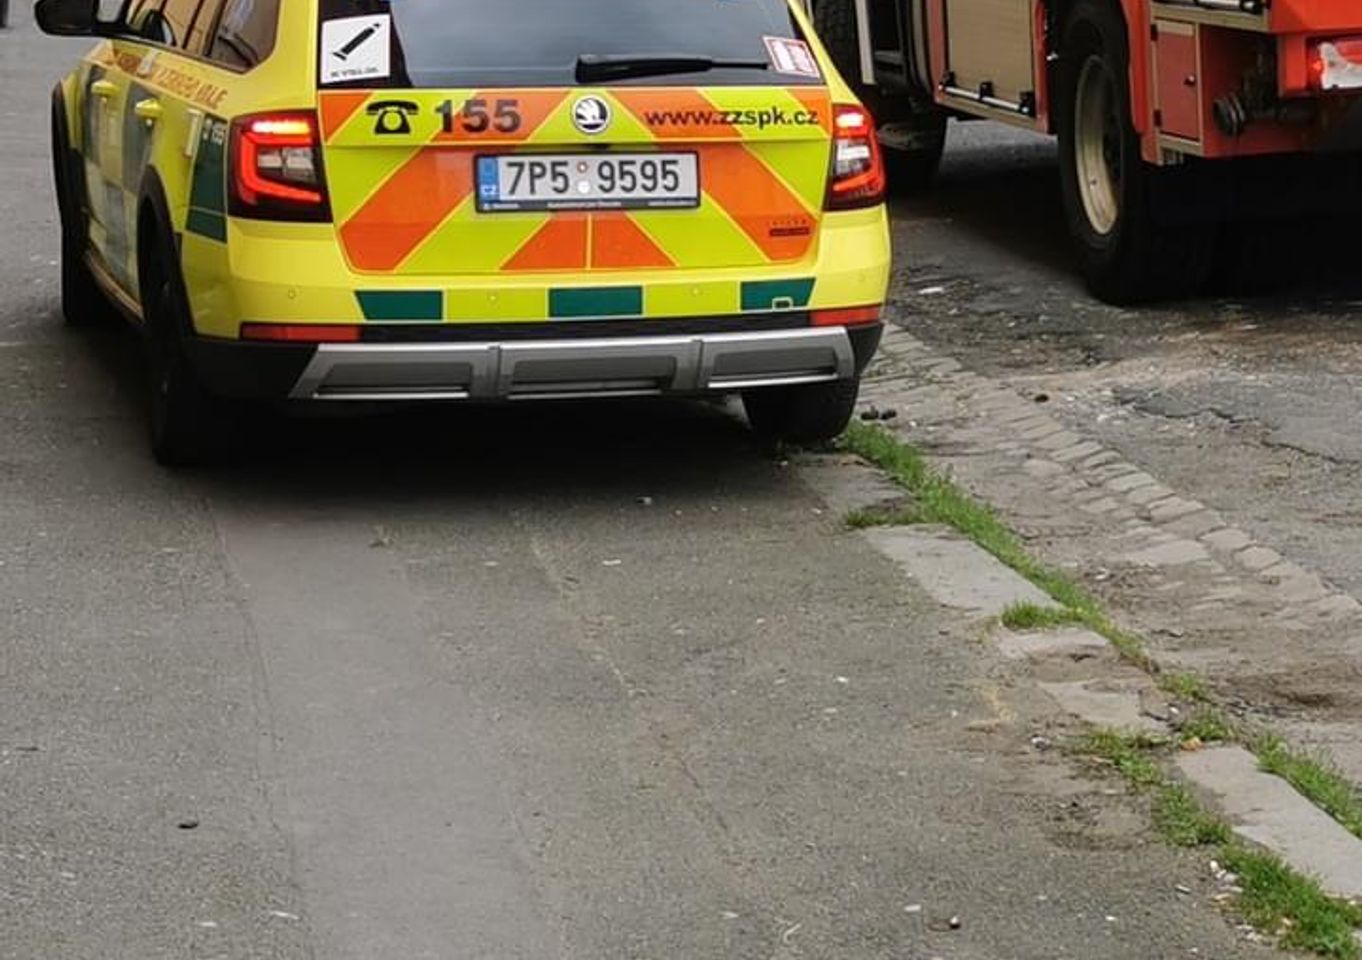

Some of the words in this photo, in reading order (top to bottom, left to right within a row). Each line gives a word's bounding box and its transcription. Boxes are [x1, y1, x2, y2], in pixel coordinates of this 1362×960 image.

[435, 99, 521, 133] 155
[644, 106, 821, 130] www.zzspk.cz
[506, 161, 570, 196] 7P5
[597, 159, 679, 193] 9595
